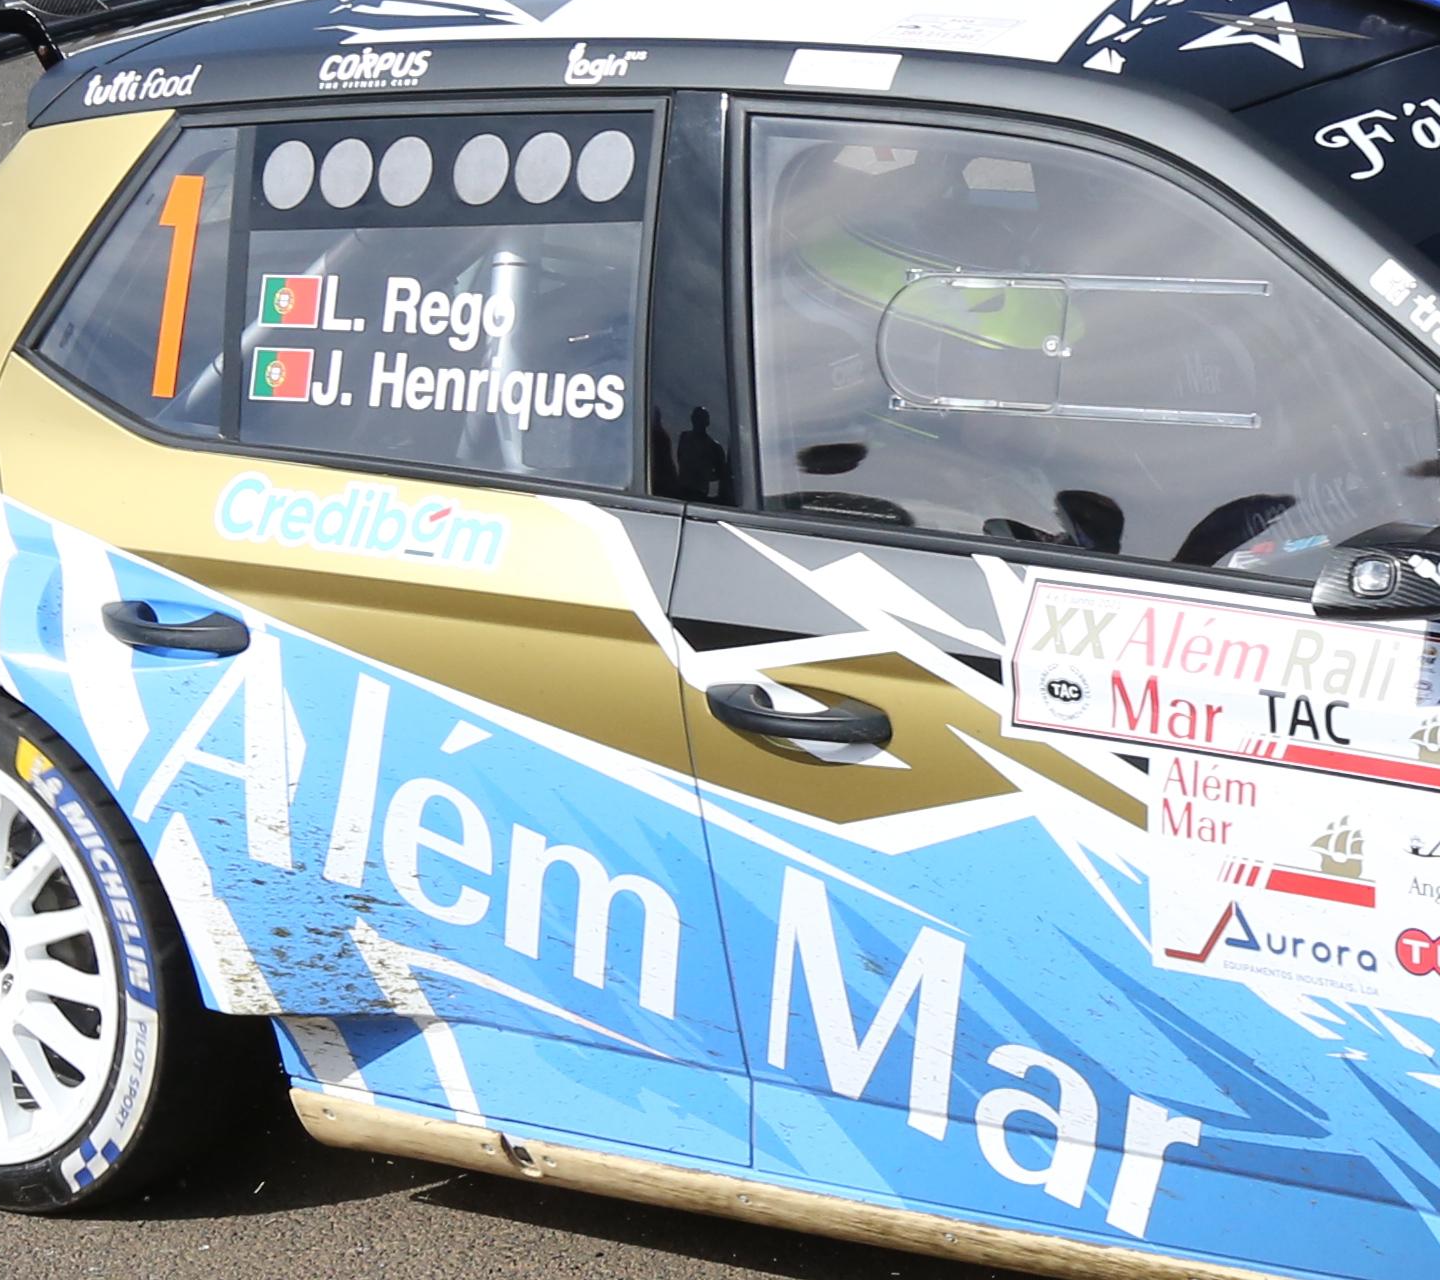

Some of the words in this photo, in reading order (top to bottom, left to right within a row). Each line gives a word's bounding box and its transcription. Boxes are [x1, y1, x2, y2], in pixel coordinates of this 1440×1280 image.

[84, 70, 143, 106] tutti
[139, 65, 202, 100] food
[319, 47, 432, 81] CORPUS
[151, 174, 206, 398] 1
[320, 274, 366, 333] L.
[382, 275, 517, 353] Rego
[312, 349, 354, 408] J.
[367, 351, 627, 432] Henriques
[217, 475, 508, 568] Credibom
[1031, 605, 1118, 660] XX
[1116, 607, 1270, 683] Além
[1280, 628, 1402, 702] Rali
[1050, 682, 1080, 700] TAC
[1110, 670, 1224, 744] Mar
[1258, 688, 1351, 746] TAC
[1162, 757, 1257, 808] Além
[1161, 797, 1233, 845] Mar
[59, 800, 152, 994] MICHELIN
[133, 634, 681, 1021] Além
[767, 865, 1203, 1240] Mar
[1164, 900, 1378, 973] Aurora
[133, 1022, 148, 1073] PILOT
[116, 1075, 141, 1130] SPORT
